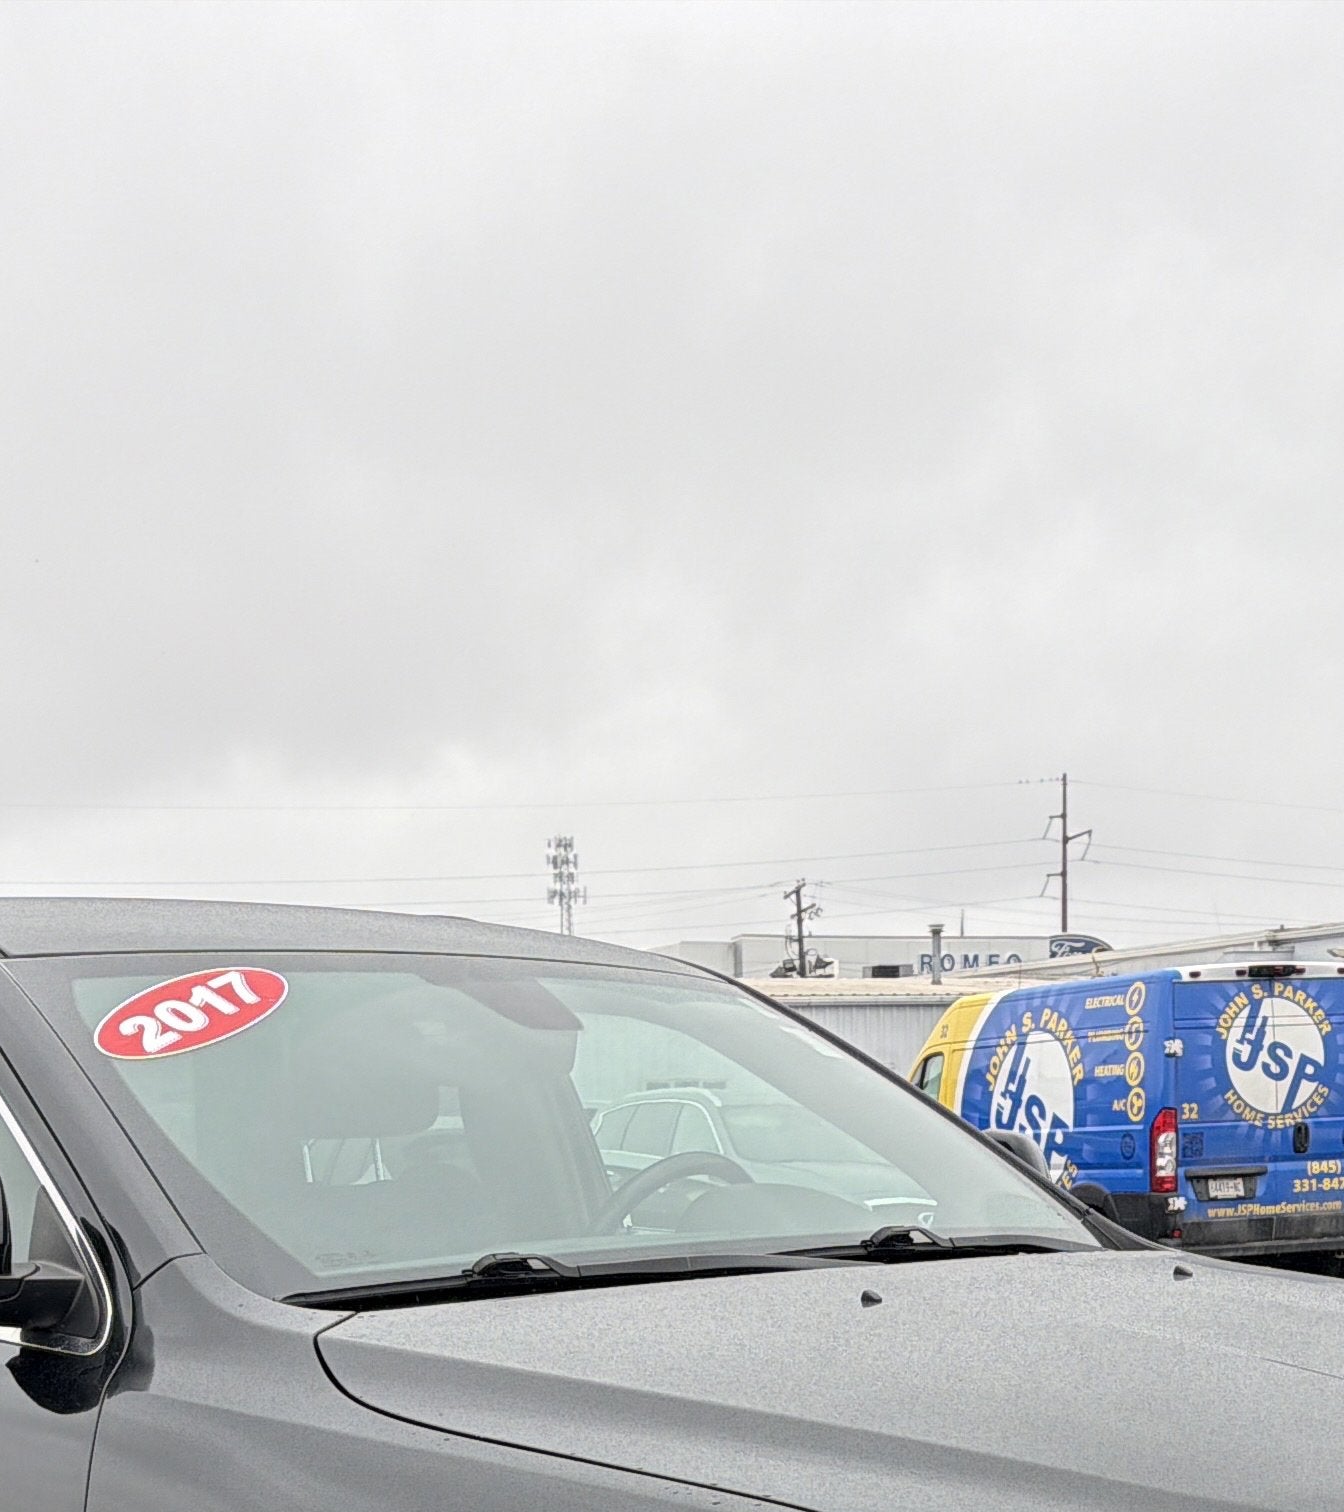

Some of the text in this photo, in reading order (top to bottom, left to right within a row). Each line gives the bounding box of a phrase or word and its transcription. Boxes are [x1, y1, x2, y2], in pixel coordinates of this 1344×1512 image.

[1085, 995, 1125, 1009] ELECTRICAL
[119, 971, 261, 1053] 2017
[1216, 982, 1332, 1040] JOHN S. PARKER
[986, 1024, 1017, 1092] JOHN
[1040, 1008, 1084, 1086] PARKER
[1094, 1064, 1125, 1077] HEATING
[1112, 1099, 1126, 1111] A/C
[1181, 1103, 1199, 1120] 32
[1224, 1084, 1329, 1129] HOME SERVICES
[1307, 1160, 1342, 1176] (845)
[1207, 1200, 1342, 1218] www.JSPHomeServices.com
